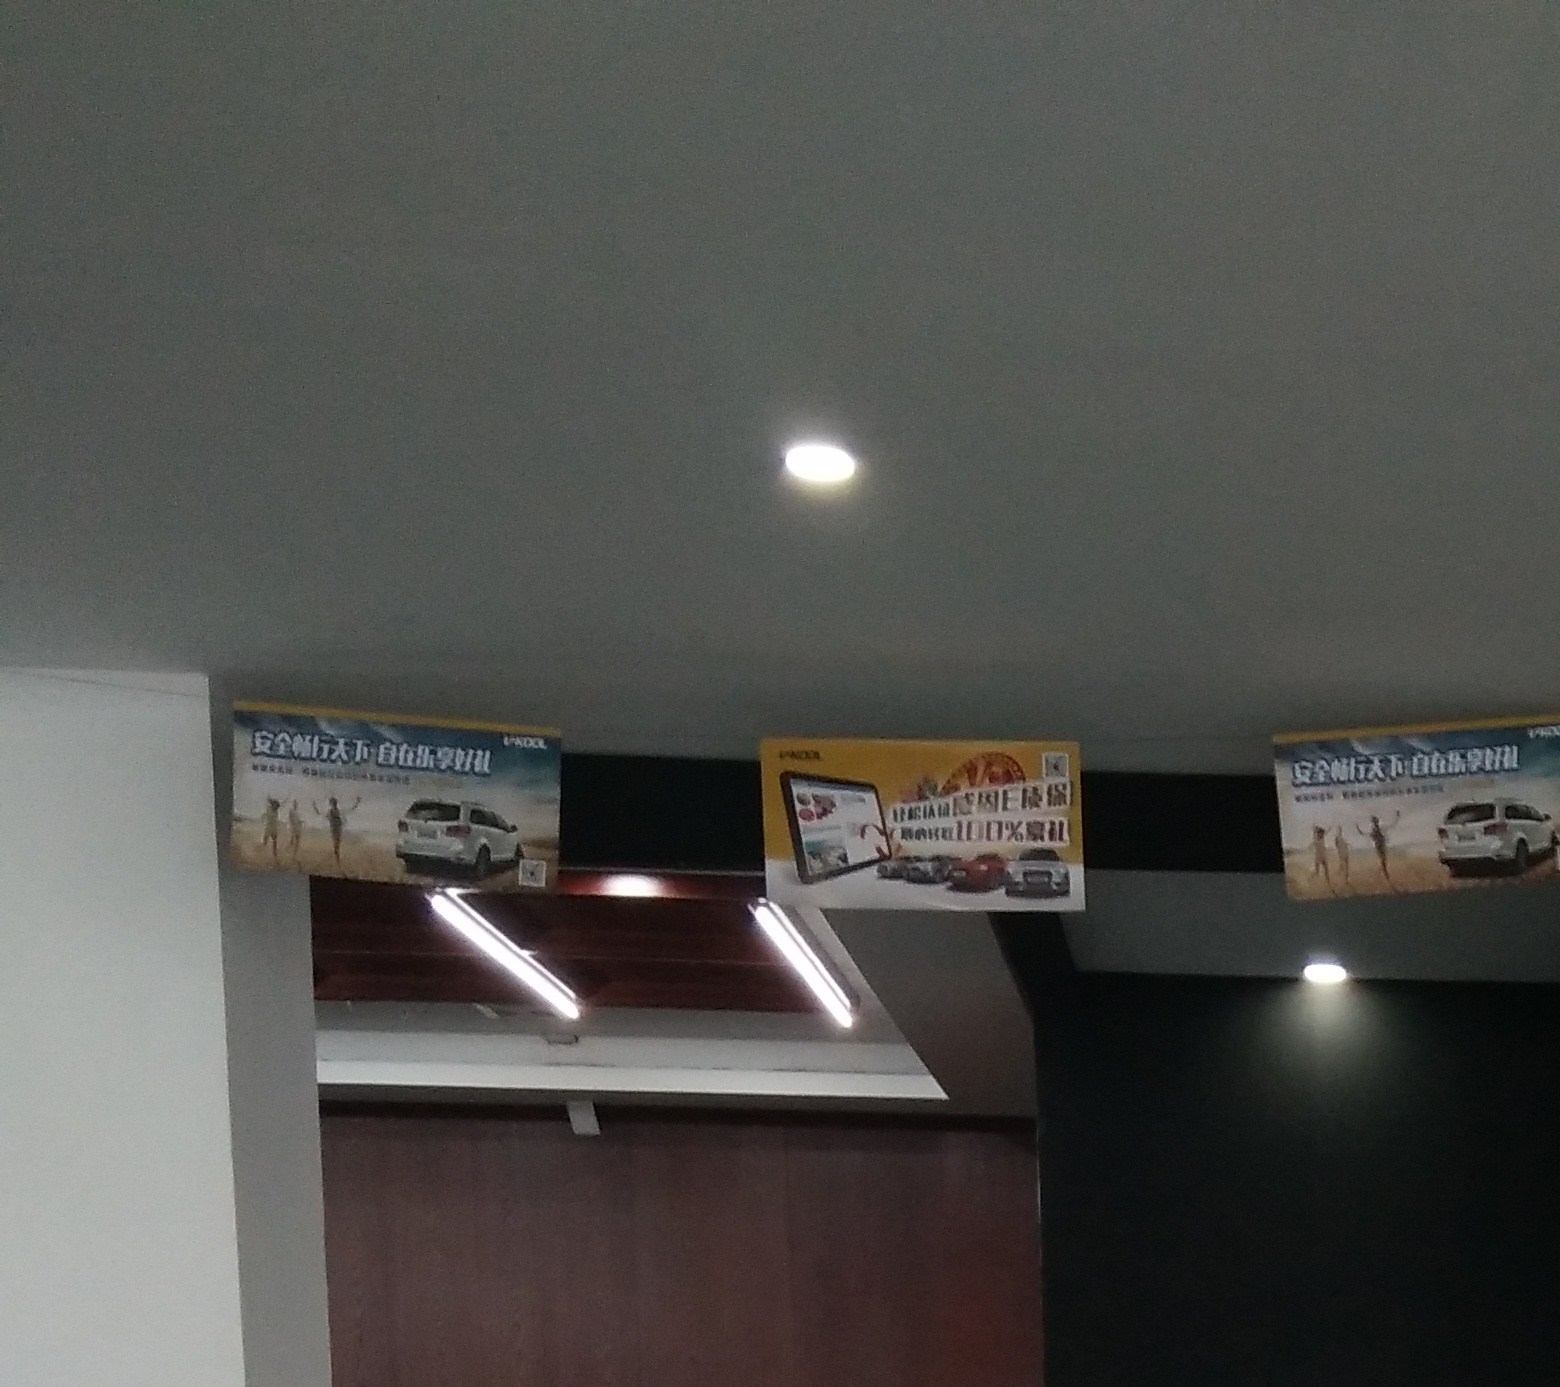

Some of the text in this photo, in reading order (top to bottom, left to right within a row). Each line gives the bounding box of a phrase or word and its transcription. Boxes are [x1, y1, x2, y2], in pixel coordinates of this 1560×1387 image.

[252, 730, 370, 765] 安全畅行天下
[376, 742, 492, 775] 自在乐享好礼
[1293, 753, 1404, 786] 安全畅行天下
